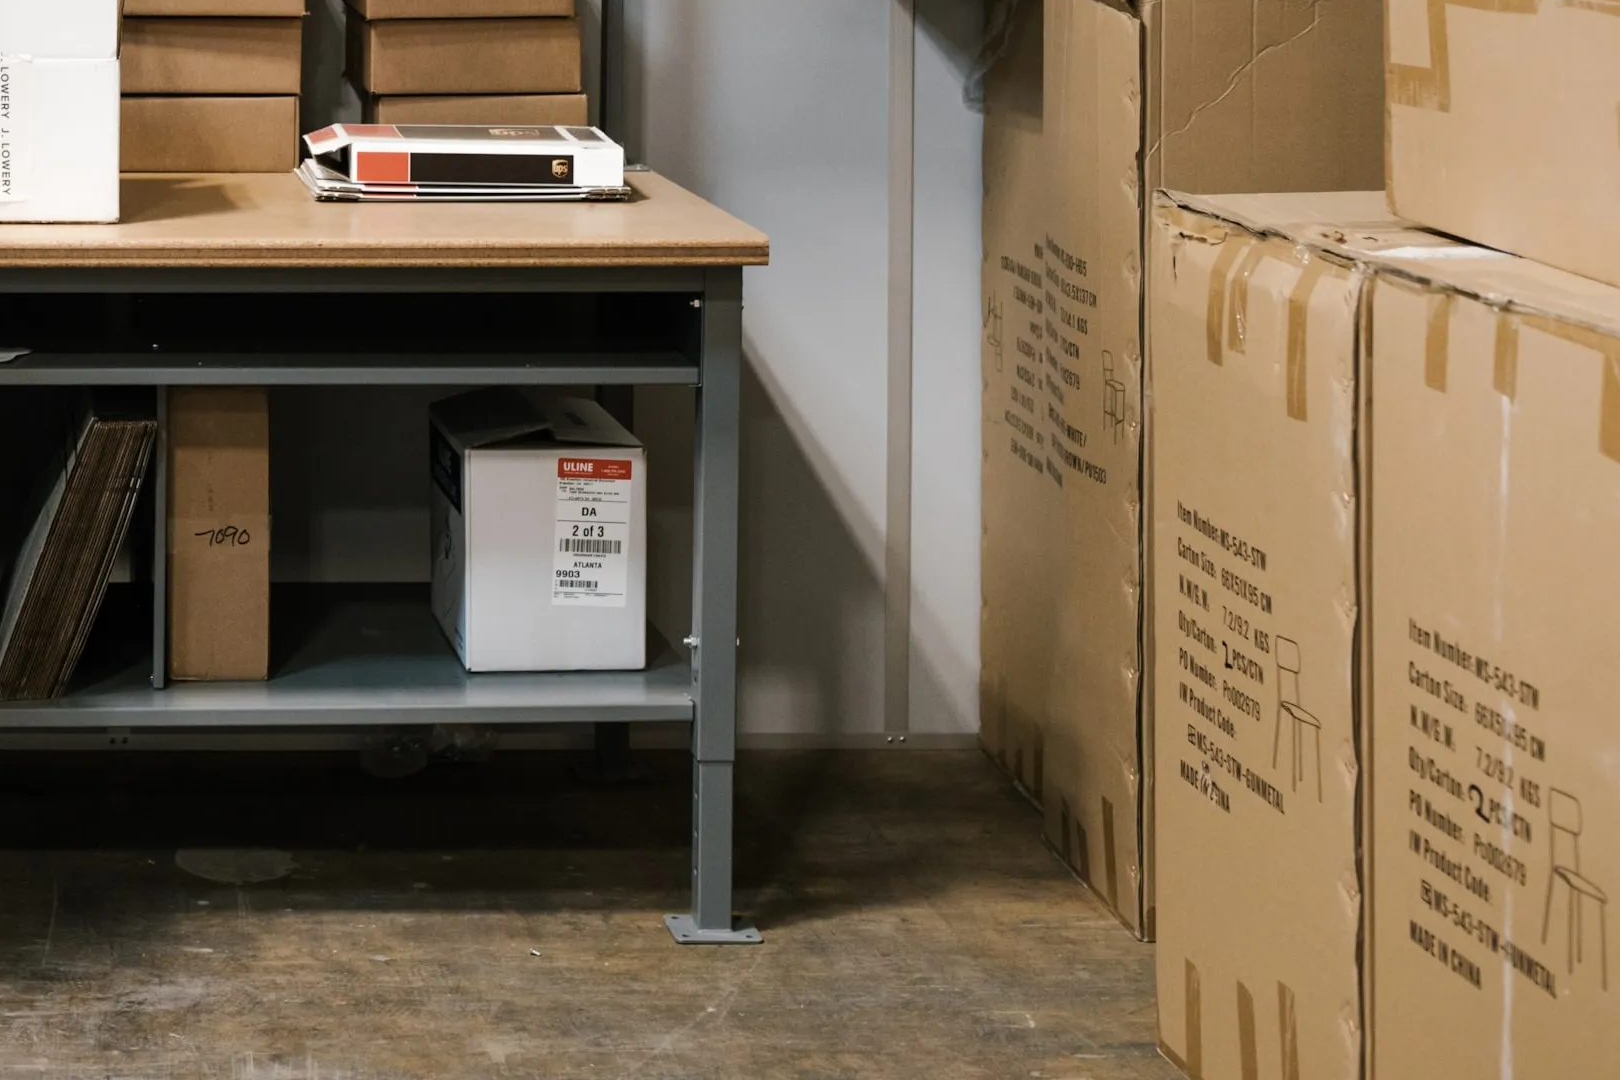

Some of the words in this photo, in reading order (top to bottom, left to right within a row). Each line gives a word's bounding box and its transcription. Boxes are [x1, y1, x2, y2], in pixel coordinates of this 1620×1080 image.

[0, 66, 10, 119] LOWERY
[1, 128, 10, 138] J.
[1, 143, 11, 195] LOWERY
[563, 462, 593, 472] ULINE
[581, 507, 597, 516] DA
[1178, 499, 1192, 526] Item
[194, 526, 250, 547] 7090
[572, 525, 579, 537] 2
[583, 525, 594, 537] of
[597, 526, 604, 537] 3
[556, 570, 580, 578] 9903
[1178, 536, 1199, 567] Carton
[1201, 551, 1217, 579] Size:
[1260, 592, 1272, 615] CM
[1179, 610, 1216, 654] Qty/Carton:
[1232, 649, 1263, 686] PCS/CTN
[1254, 628, 1269, 654] KGS
[1409, 617, 1431, 649] Item
[1179, 647, 1188, 671] PO
[1189, 688, 1216, 726] Product
[1409, 661, 1441, 699] Carton
[1530, 735, 1545, 762] CM
[1180, 759, 1198, 790] MADE
[1409, 746, 1466, 802] Qty/Carton:
[1468, 784, 1491, 824] 2
[1409, 789, 1422, 817] PO
[1520, 776, 1541, 809] KGS
[1424, 838, 1462, 885] Product
[1410, 920, 1436, 958] MADE
[1438, 940, 1449, 967] IN
[1451, 948, 1482, 990] CHINA
